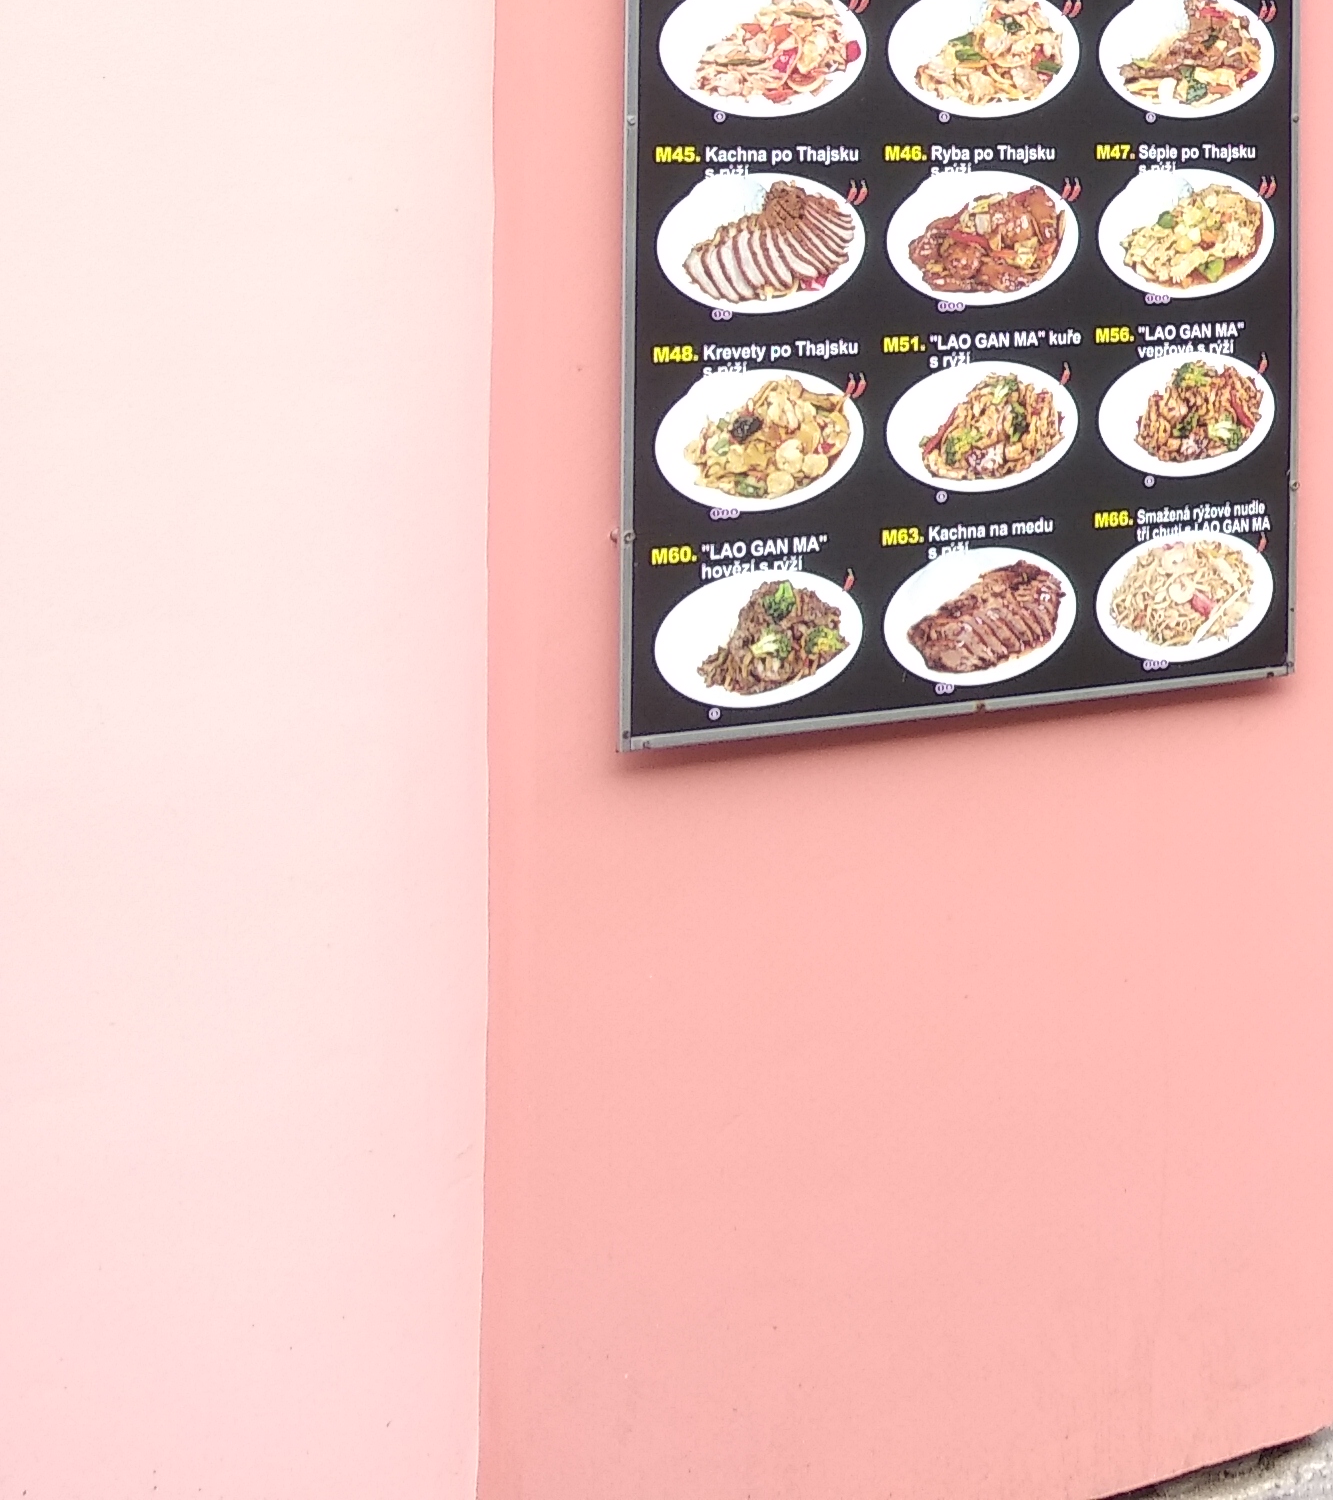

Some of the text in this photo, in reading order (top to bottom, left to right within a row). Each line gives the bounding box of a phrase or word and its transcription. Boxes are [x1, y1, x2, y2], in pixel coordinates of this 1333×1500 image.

[655, 145, 859, 166] M45. Kachna po Thajsku
[884, 144, 1056, 165] M46. Ryba po Thajsku
[1096, 143, 1136, 161] M47.
[1181, 147, 1200, 163] po
[1202, 143, 1256, 163] Thajsku
[884, 336, 926, 353] M51.
[975, 334, 1010, 349] GAN
[1048, 328, 1082, 346] kuře
[1095, 326, 1135, 344] M56.
[1179, 322, 1212, 344] GAN
[653, 339, 859, 364] M48. Krevety po Thajsku
[881, 527, 924, 546] M63.
[928, 523, 986, 544] Kachna
[989, 523, 1009, 538] na
[651, 545, 698, 565] M60.
[751, 538, 788, 557] GAN
